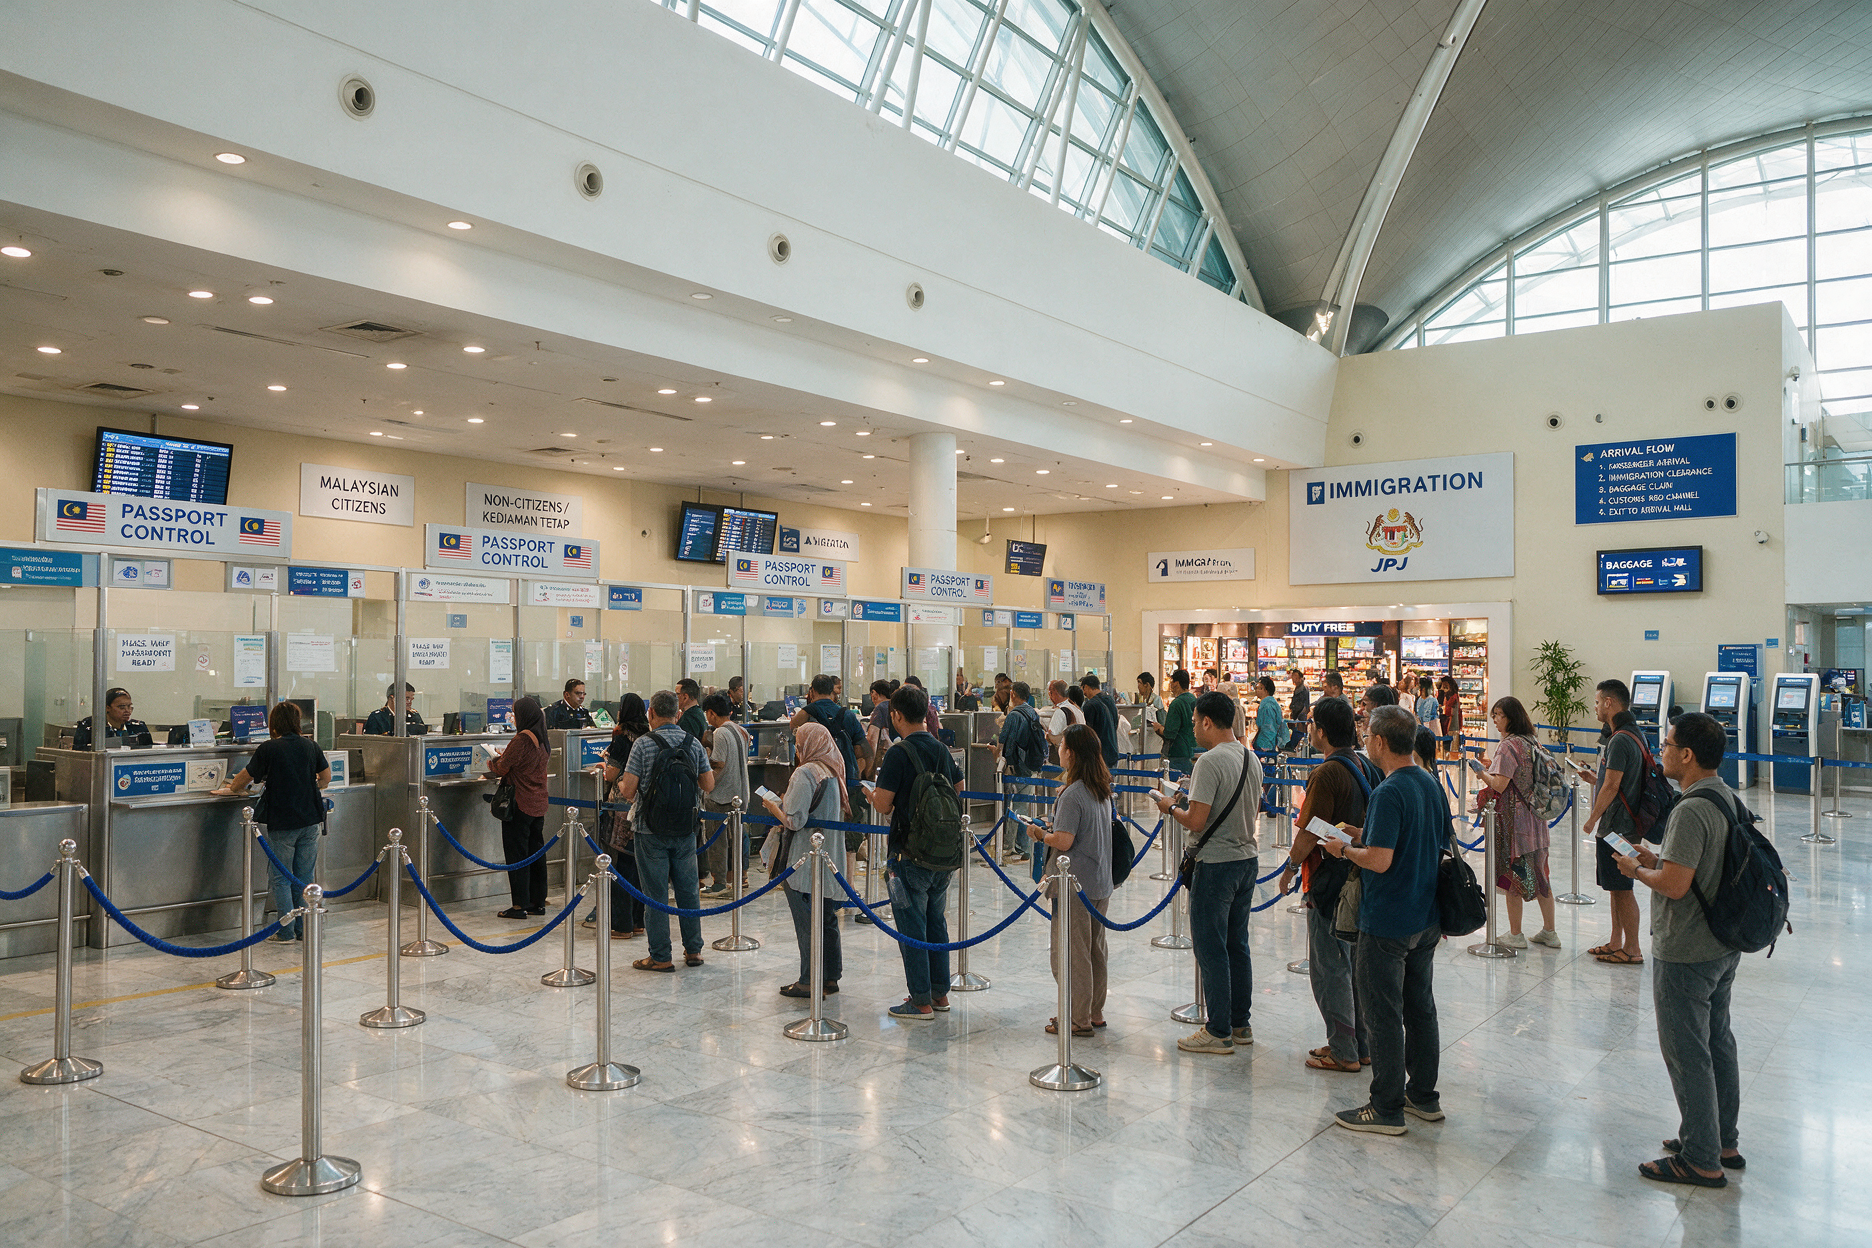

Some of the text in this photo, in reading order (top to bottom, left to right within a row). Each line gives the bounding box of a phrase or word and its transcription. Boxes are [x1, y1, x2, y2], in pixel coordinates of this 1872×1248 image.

[1599, 444, 1675, 458] ARRIVAL FLOW
[1329, 471, 1484, 499] IMMIGRATION
[1598, 474, 1606, 482] 2.
[320, 475, 399, 498] MALAYSIAN
[1608, 483, 1647, 494] BAGGAGE
[331, 498, 386, 516] CITIZENS
[484, 493, 563, 514] NON-CITIZENS
[121, 503, 229, 528] PASSPORT
[540, 516, 570, 530] TETAP
[120, 523, 216, 546] CONTROL
[481, 535, 556, 554] PASSPORT
[481, 551, 549, 569] CONTROL
[764, 560, 817, 575] PASSPORT
[1370, 556, 1409, 573] JPJ
[1605, 559, 1653, 571] BAGGAGE
[764, 573, 811, 587] CONTROL
[930, 573, 971, 587] PASSPORT
[930, 586, 967, 599] CONTROL
[1291, 622, 1356, 633] DUTY FREE
